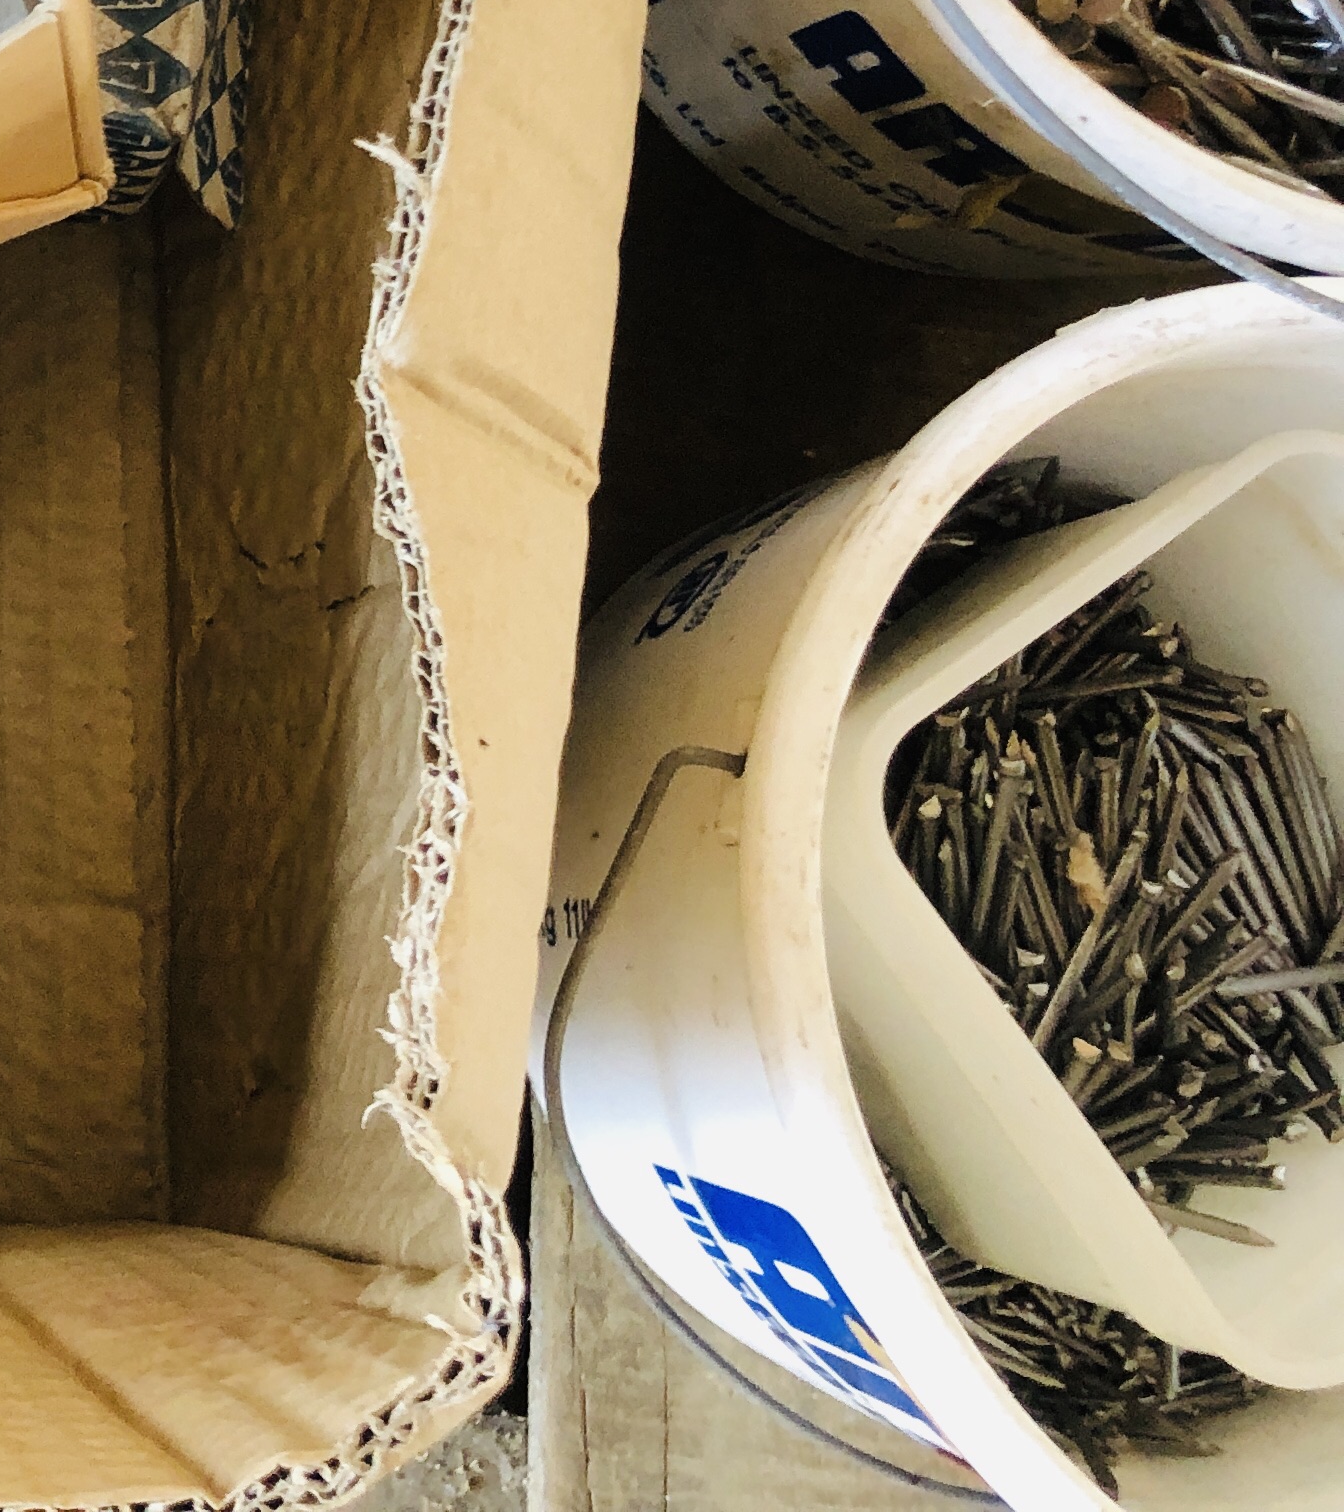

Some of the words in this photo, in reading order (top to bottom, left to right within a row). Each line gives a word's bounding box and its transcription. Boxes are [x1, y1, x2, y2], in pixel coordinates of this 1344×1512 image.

[720, 57, 754, 89] to
[675, 102, 728, 149] Ltd
[737, 46, 876, 171] LINSEED
